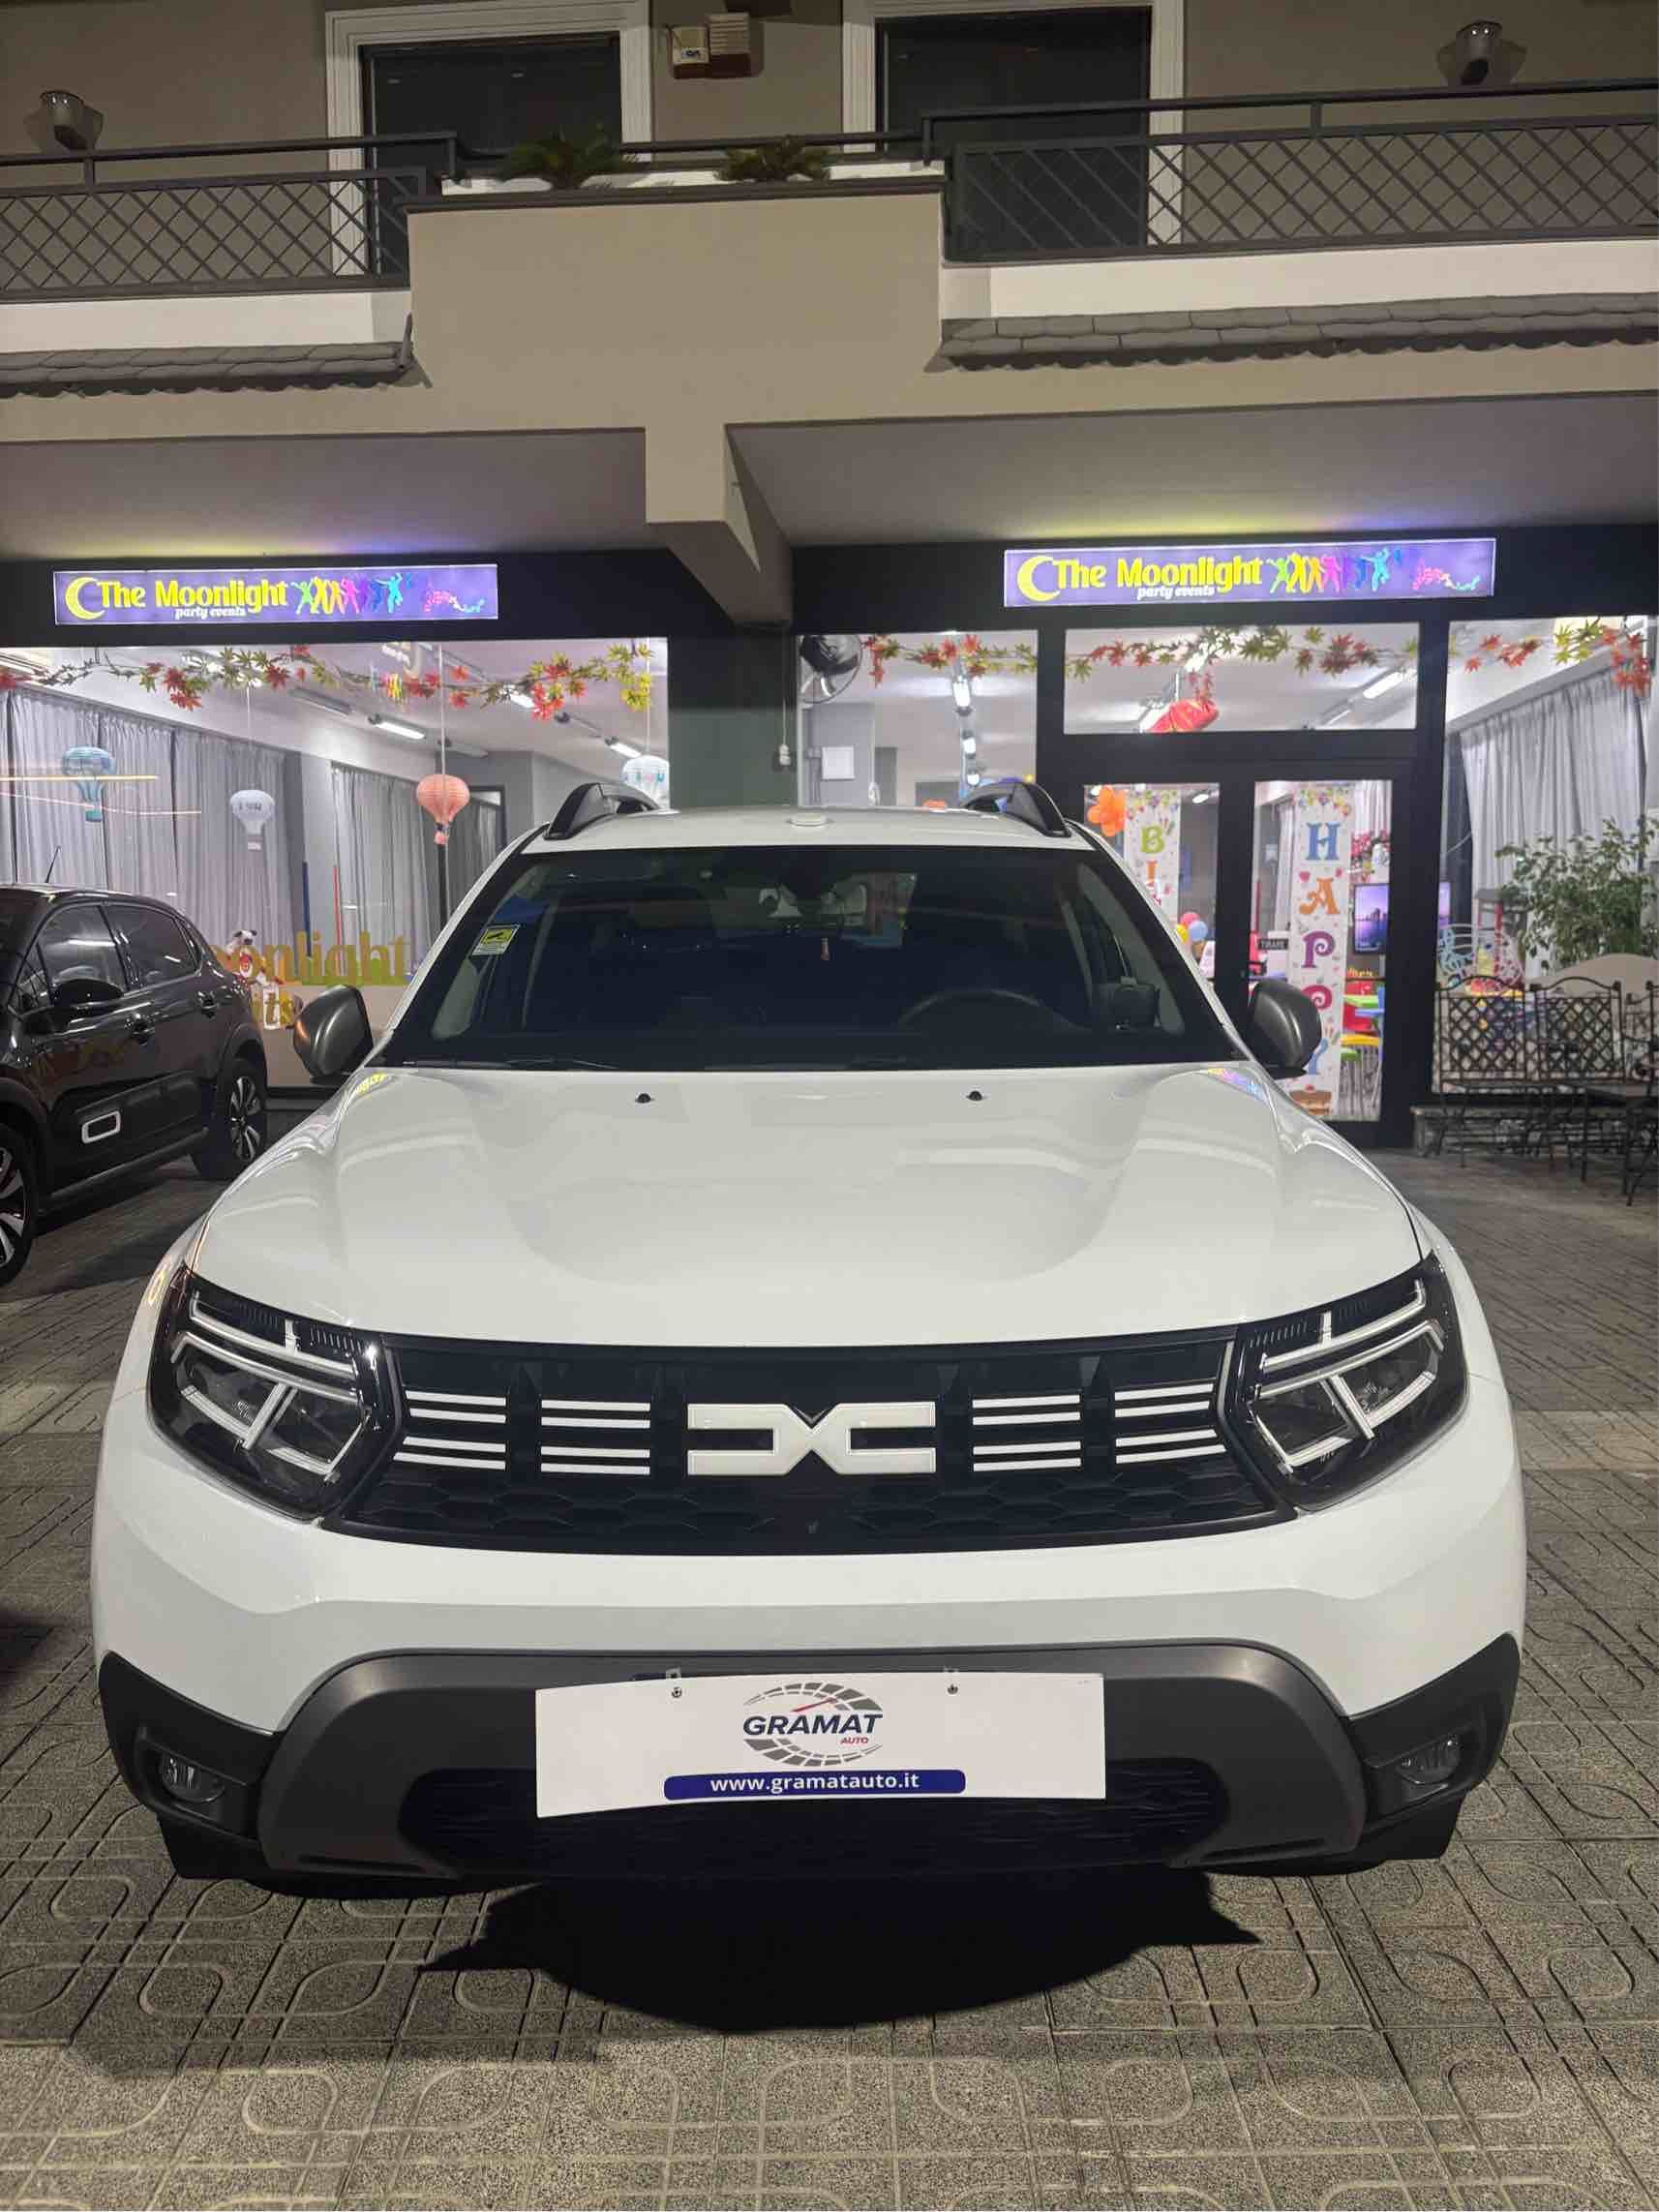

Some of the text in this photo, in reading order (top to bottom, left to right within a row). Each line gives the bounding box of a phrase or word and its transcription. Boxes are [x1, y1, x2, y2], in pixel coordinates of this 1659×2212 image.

[1053, 556, 1263, 593] The Moonlight
[97, 579, 288, 614] The Moonlight
[1136, 585, 1216, 600] party events
[175, 606, 247, 620] party events
[742, 1713, 884, 1736] GRAMAT
[840, 1736, 869, 1745] AUTO
[710, 1772, 920, 1795] www.gramatauto.it
